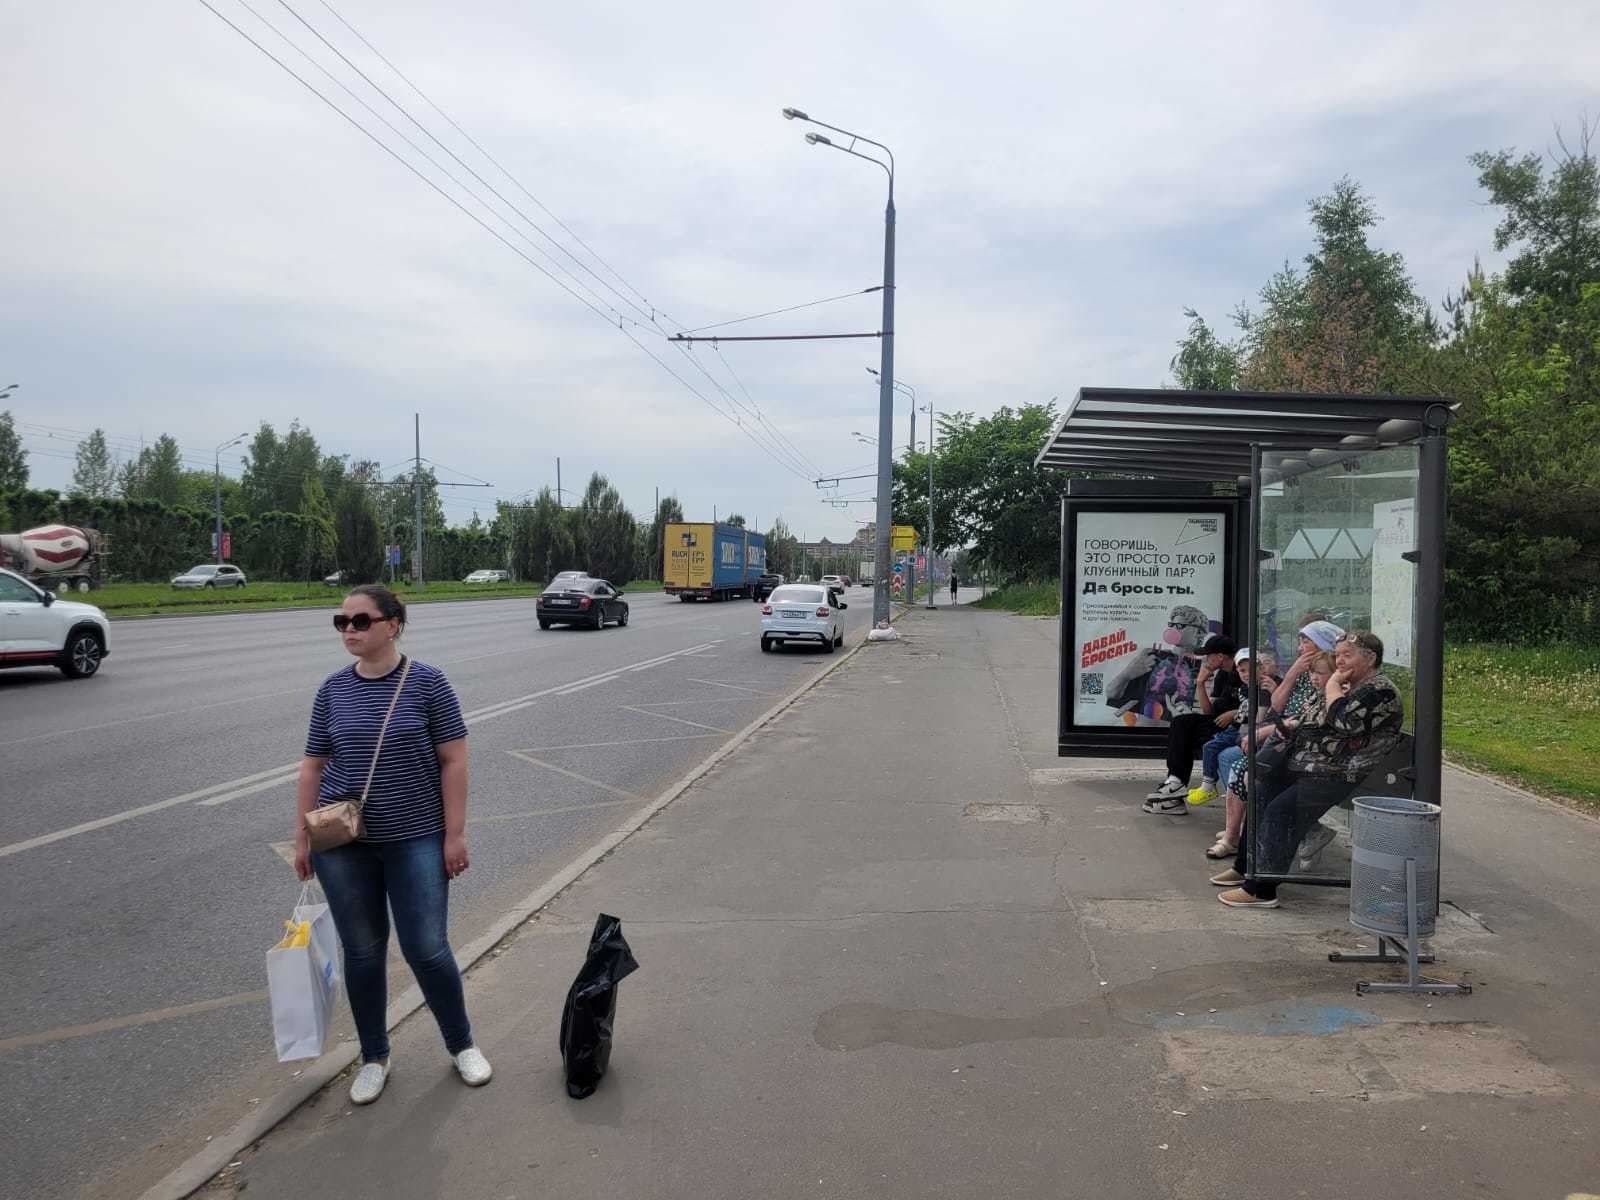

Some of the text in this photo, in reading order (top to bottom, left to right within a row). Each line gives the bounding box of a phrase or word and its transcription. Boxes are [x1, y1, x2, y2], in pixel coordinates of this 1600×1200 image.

[1084, 539, 1158, 551] ГОВОРИШЬ,
[1084, 552, 1216, 565] ЭТО ПРОСТО ТАКОЙ
[1166, 567, 1195, 578] ПАР?
[1083, 581, 1195, 596] Да брось ты.
[1082, 628, 1127, 656] ДАВАЙ
[1082, 641, 1137, 668] БРОСАТЬ
